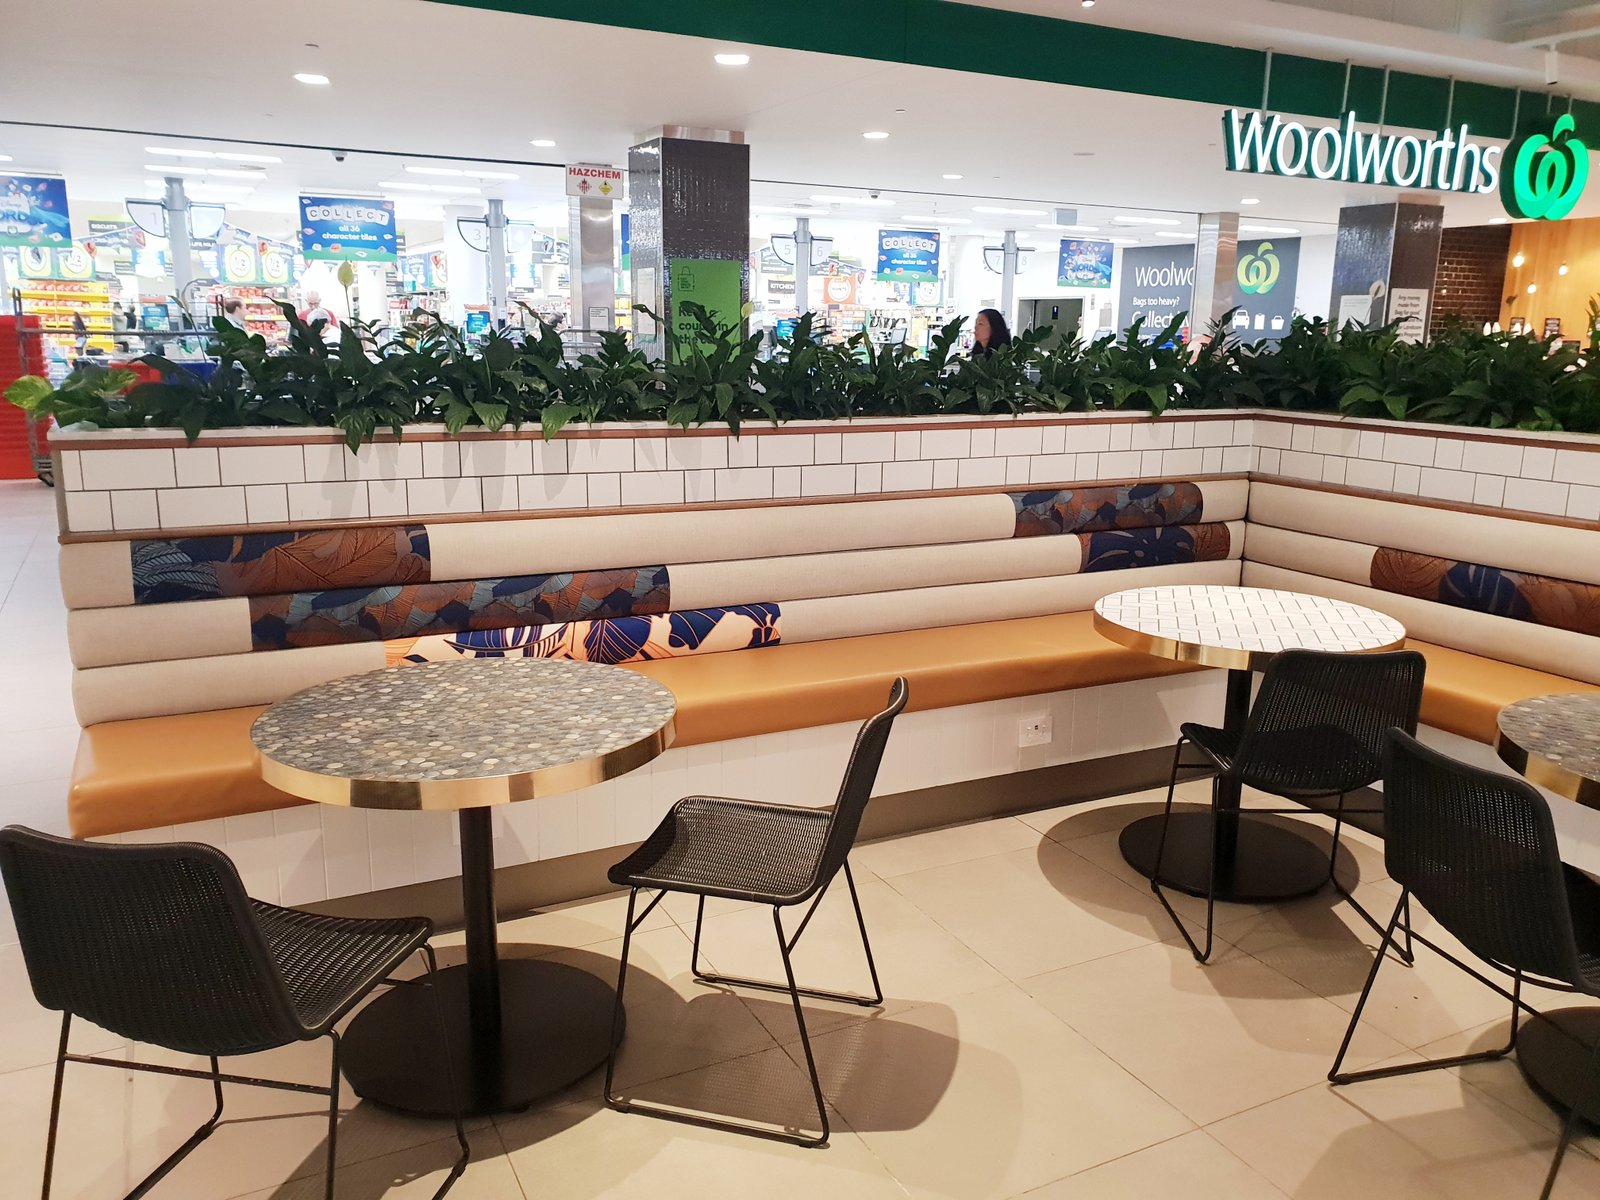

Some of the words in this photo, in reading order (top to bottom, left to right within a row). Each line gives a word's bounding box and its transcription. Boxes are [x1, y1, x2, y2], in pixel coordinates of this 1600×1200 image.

[1226, 108, 1501, 194] Woolworths
[569, 167, 621, 180] HAZCHEM
[309, 208, 386, 221] COLLECT
[322, 232, 359, 240] character
[360, 233, 377, 241] tiles
[472, 229, 481, 241] 3
[784, 244, 791, 255] 5
[884, 240, 935, 249] COLLECT
[817, 247, 823, 257] 6
[1132, 296, 1147, 307] Bags
[1148, 297, 1157, 305] too
[1158, 296, 1180, 307] heavy?
[1131, 310, 1174, 328] Collect
